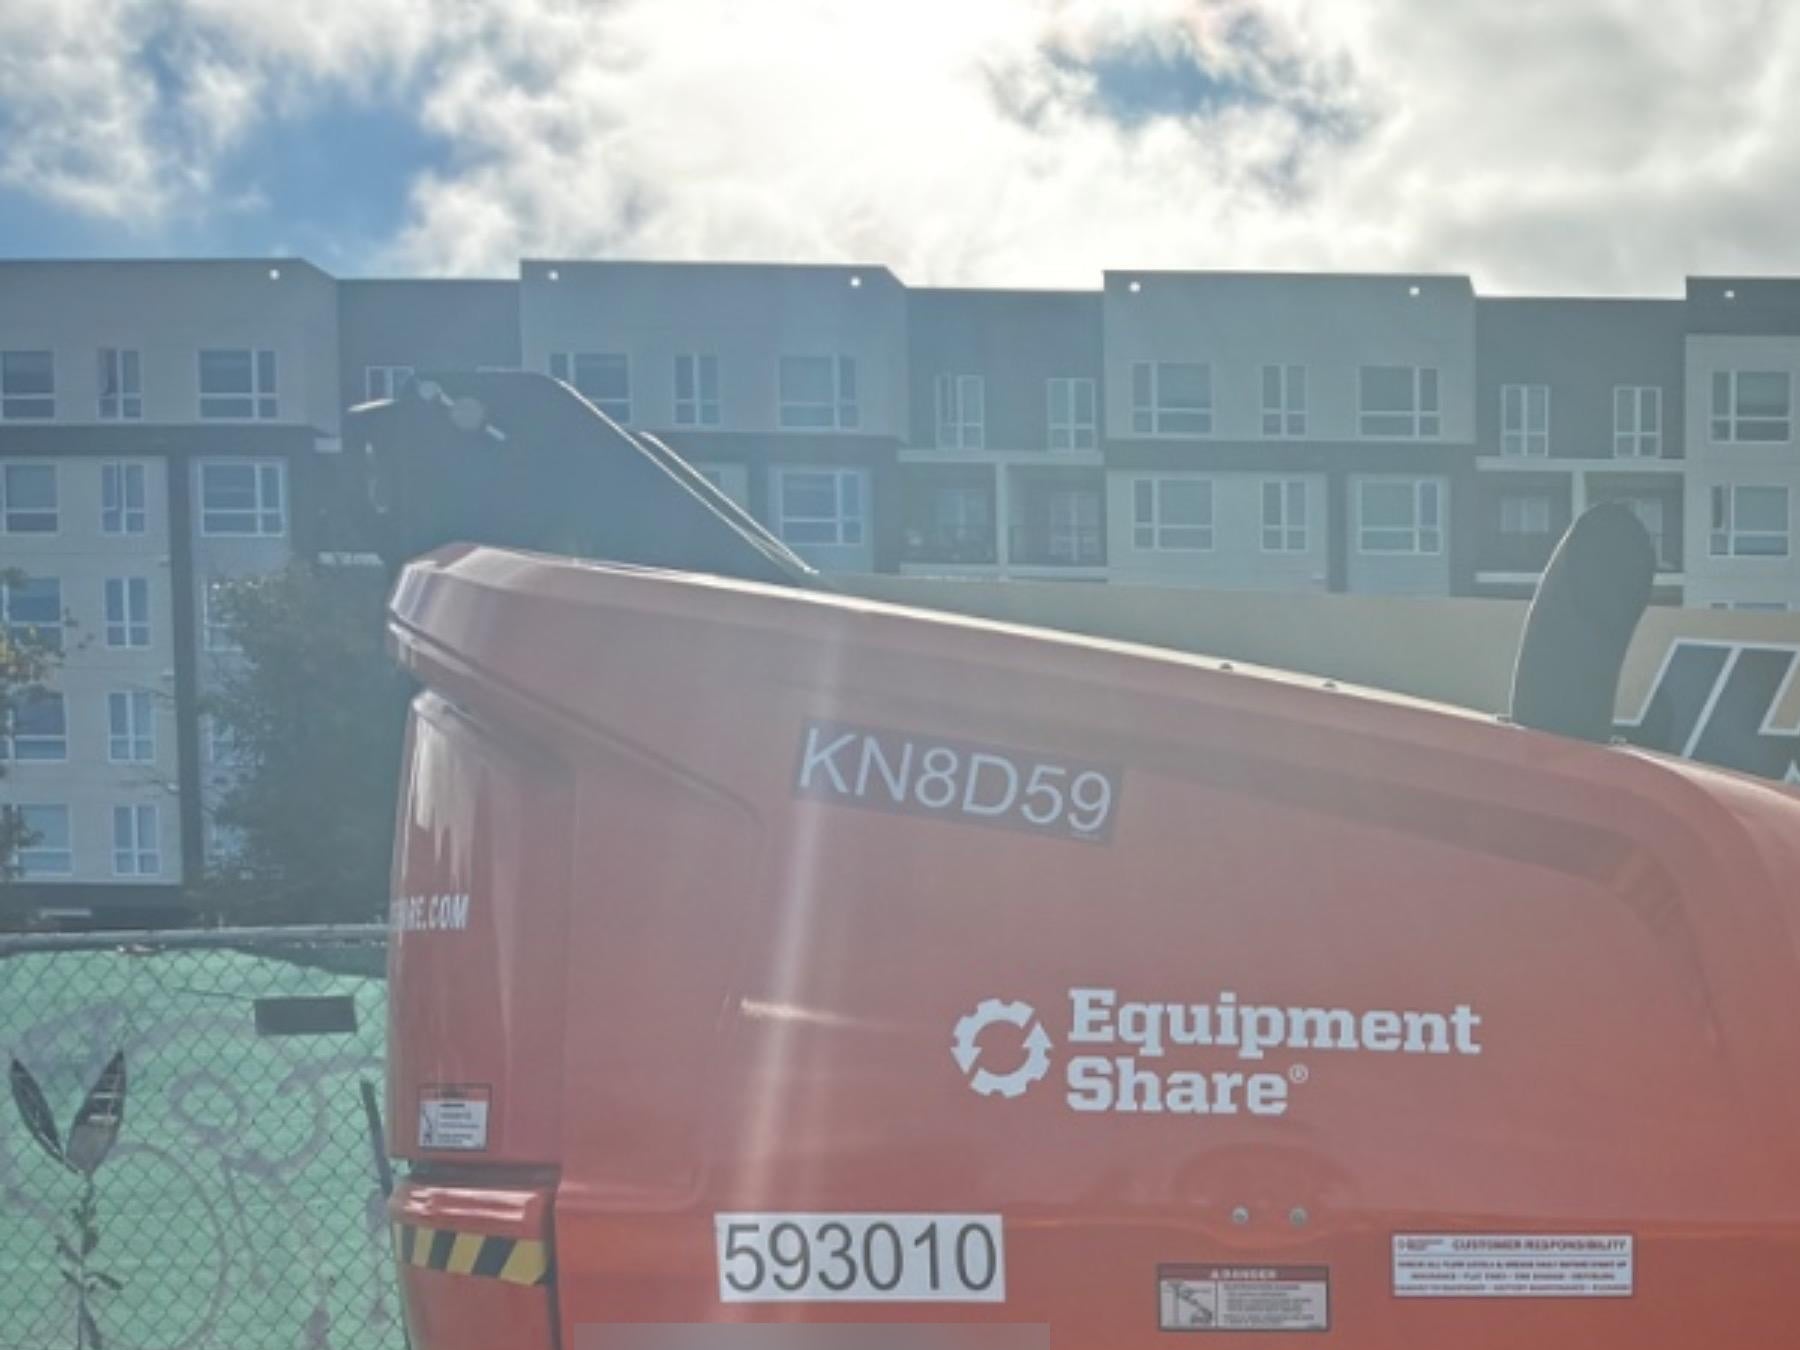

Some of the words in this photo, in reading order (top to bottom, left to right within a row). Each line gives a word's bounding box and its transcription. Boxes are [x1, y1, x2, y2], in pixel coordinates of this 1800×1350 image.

[800, 728, 1111, 832] KN8D59
[1068, 988, 1482, 1059] Equipment
[724, 1221, 997, 1292] 593010
